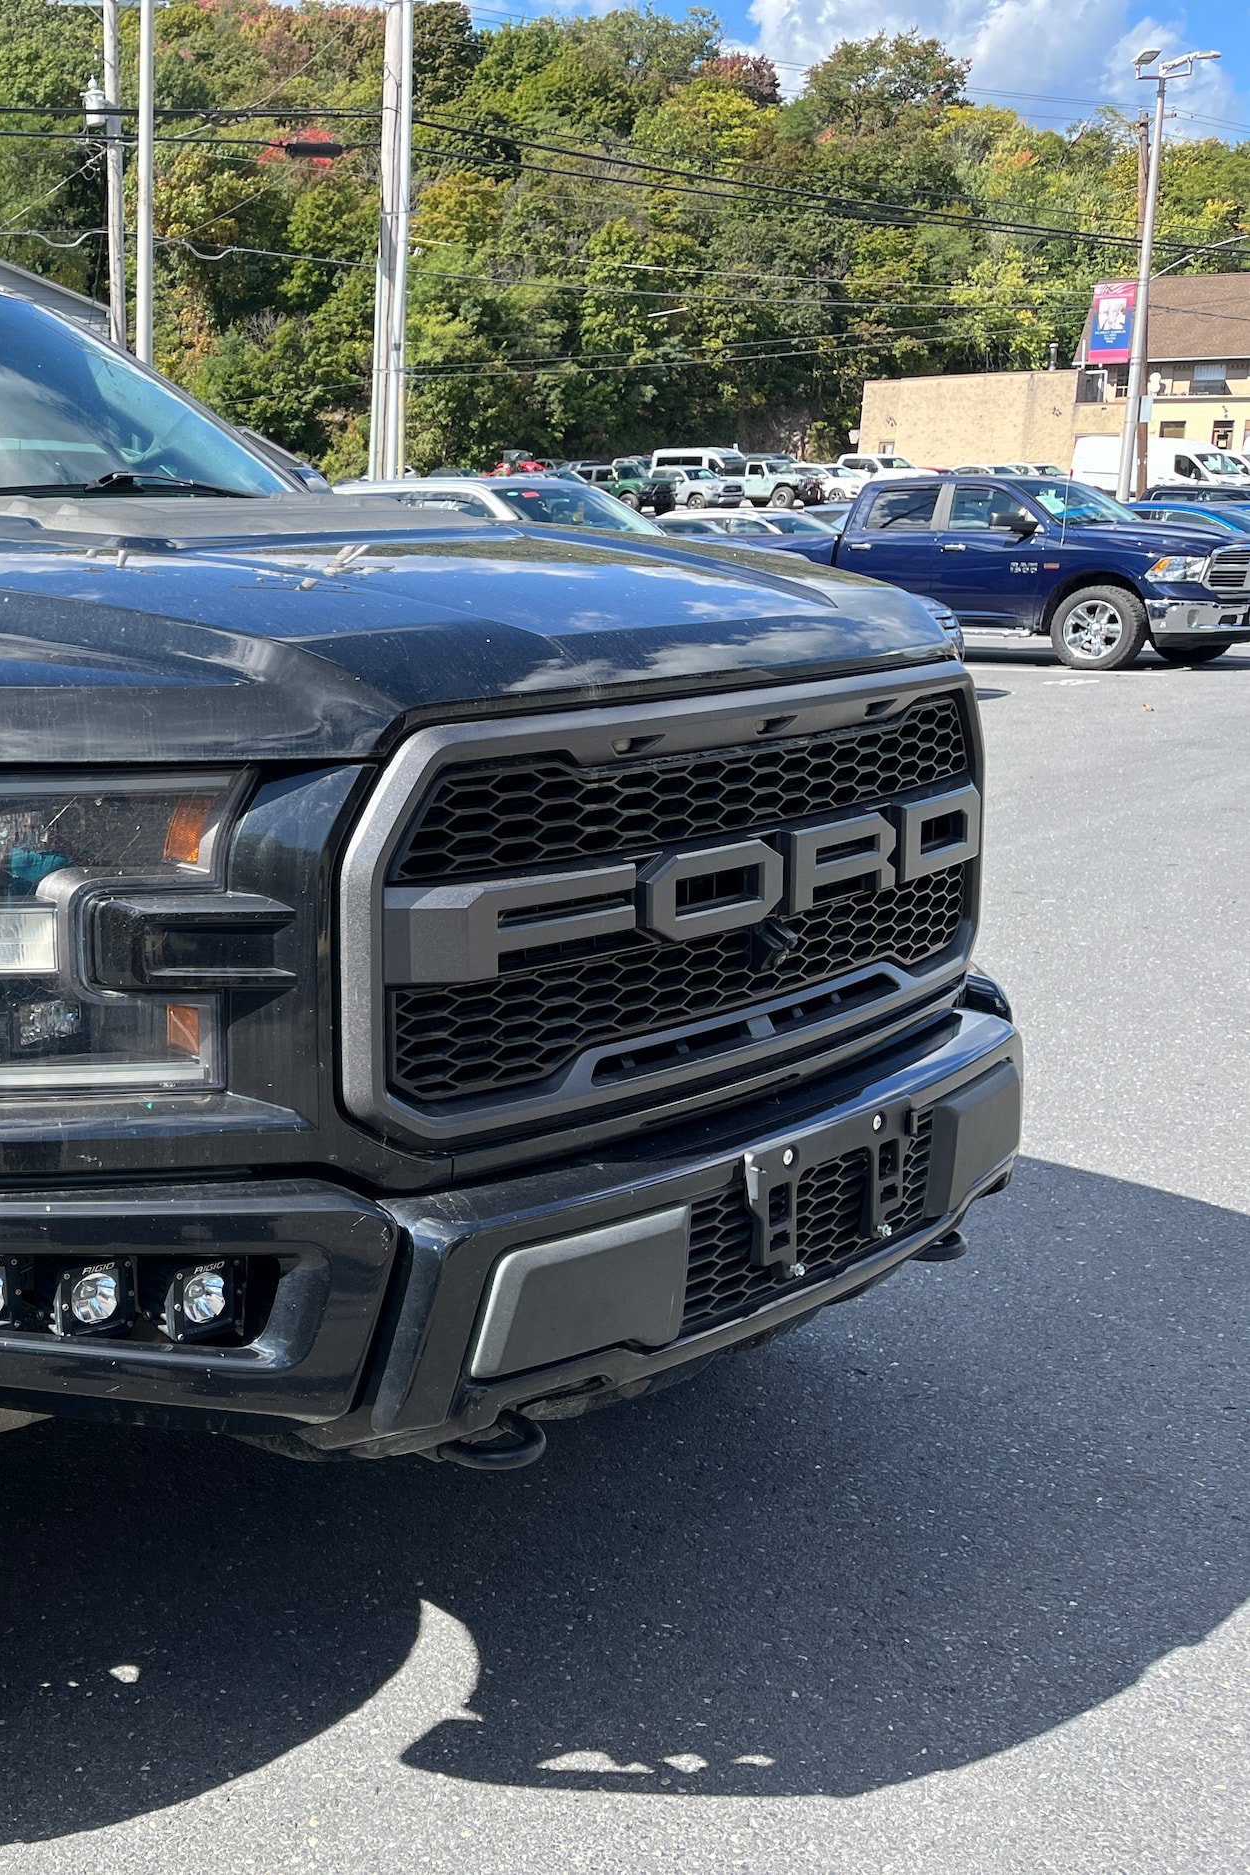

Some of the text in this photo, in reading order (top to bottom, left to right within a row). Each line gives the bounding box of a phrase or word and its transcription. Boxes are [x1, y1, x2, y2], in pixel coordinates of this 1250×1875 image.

[405, 783, 982, 984] FORD
[82, 1261, 116, 1275] RIGID
[194, 1261, 225, 1274] RIGID
